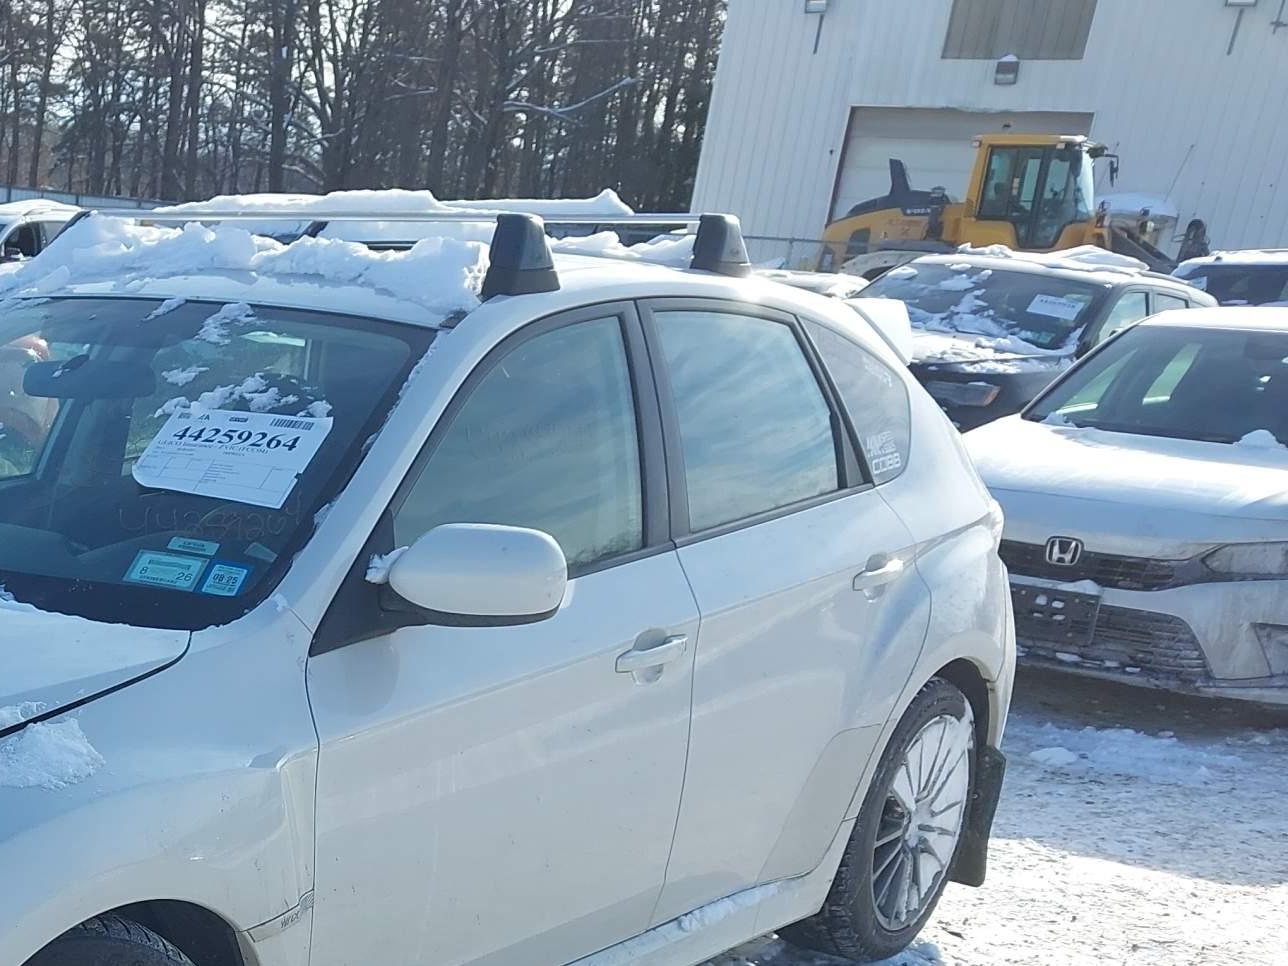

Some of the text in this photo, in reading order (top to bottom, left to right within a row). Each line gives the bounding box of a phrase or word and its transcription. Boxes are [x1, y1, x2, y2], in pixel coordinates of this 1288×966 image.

[173, 426, 301, 451] 44259264
[872, 453, 901, 474] COBB
[139, 566, 149, 575] 8
[175, 571, 193, 582] 26
